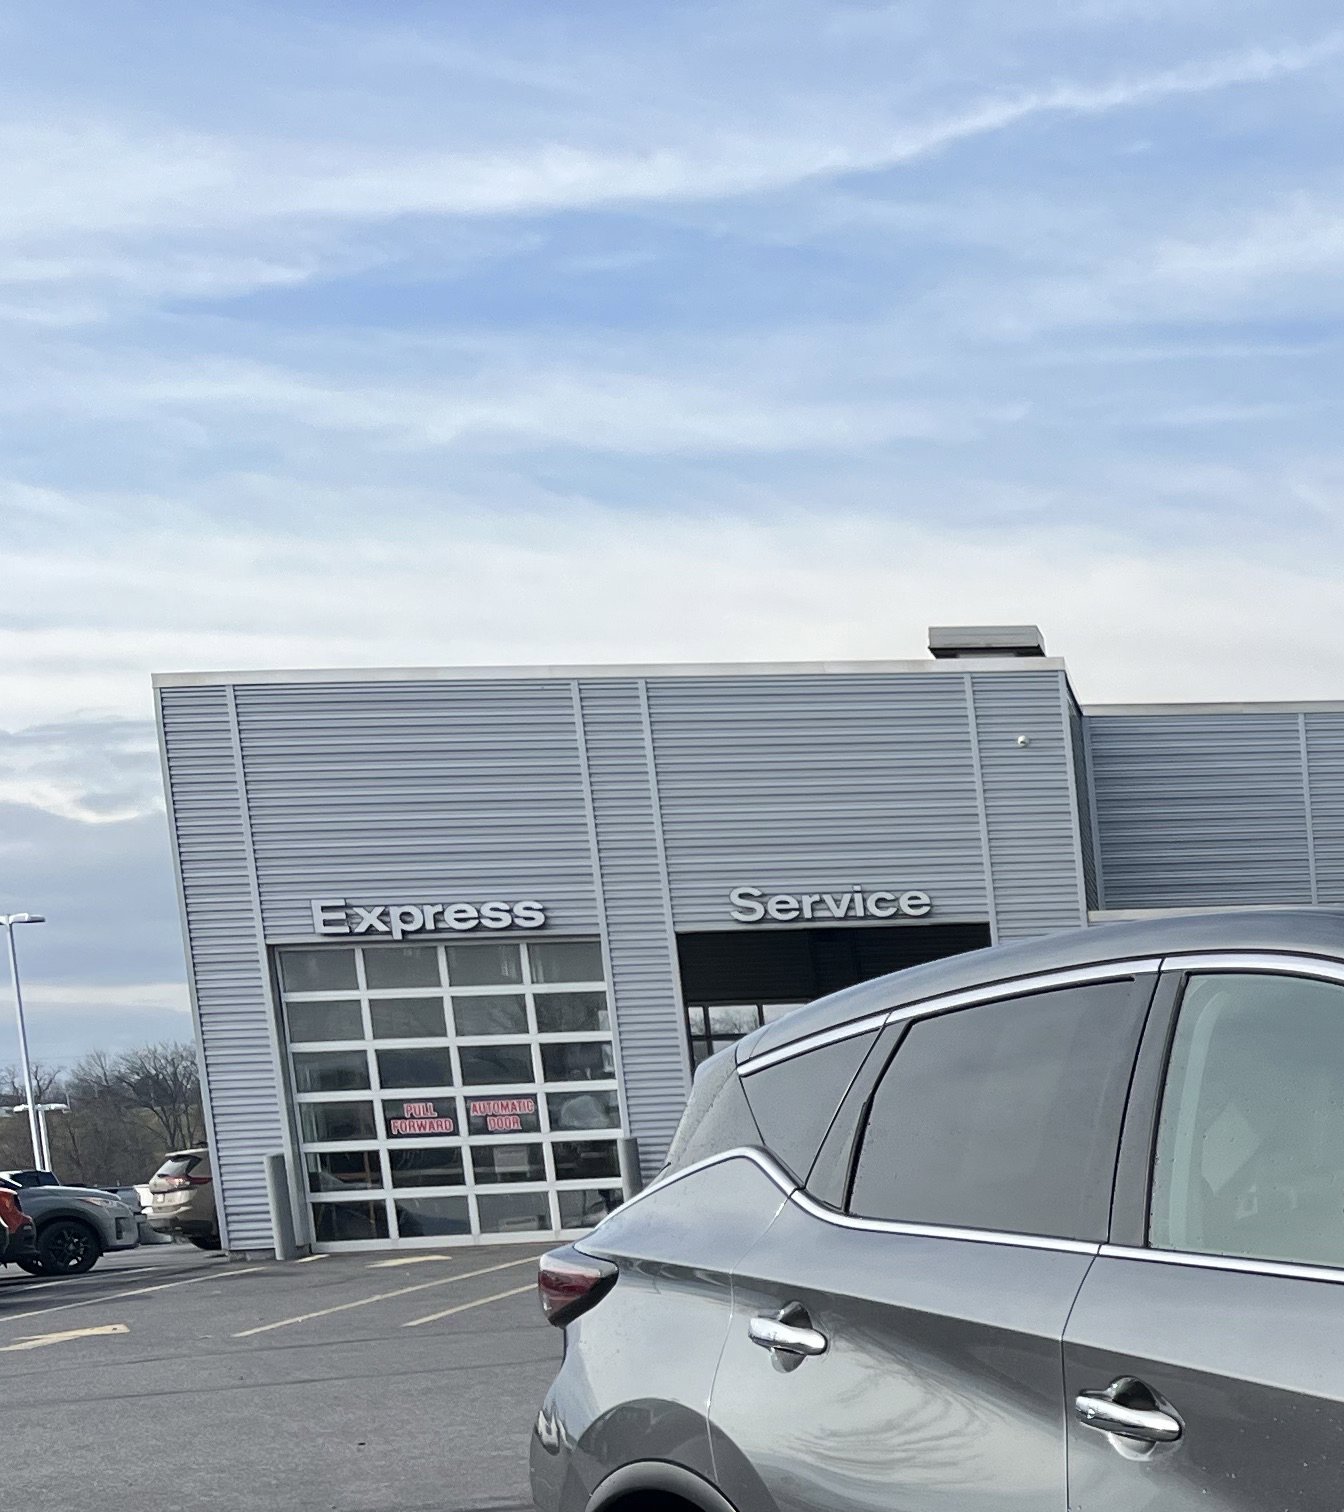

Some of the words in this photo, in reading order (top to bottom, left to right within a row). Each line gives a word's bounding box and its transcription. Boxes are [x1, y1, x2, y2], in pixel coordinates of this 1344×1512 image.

[729, 885, 931, 922] Service
[311, 899, 545, 940] Express
[404, 1103, 437, 1118] PULL
[470, 1099, 534, 1116] AUTOMATIC
[391, 1118, 453, 1134] FORWARD
[487, 1115, 522, 1131] DOOR
